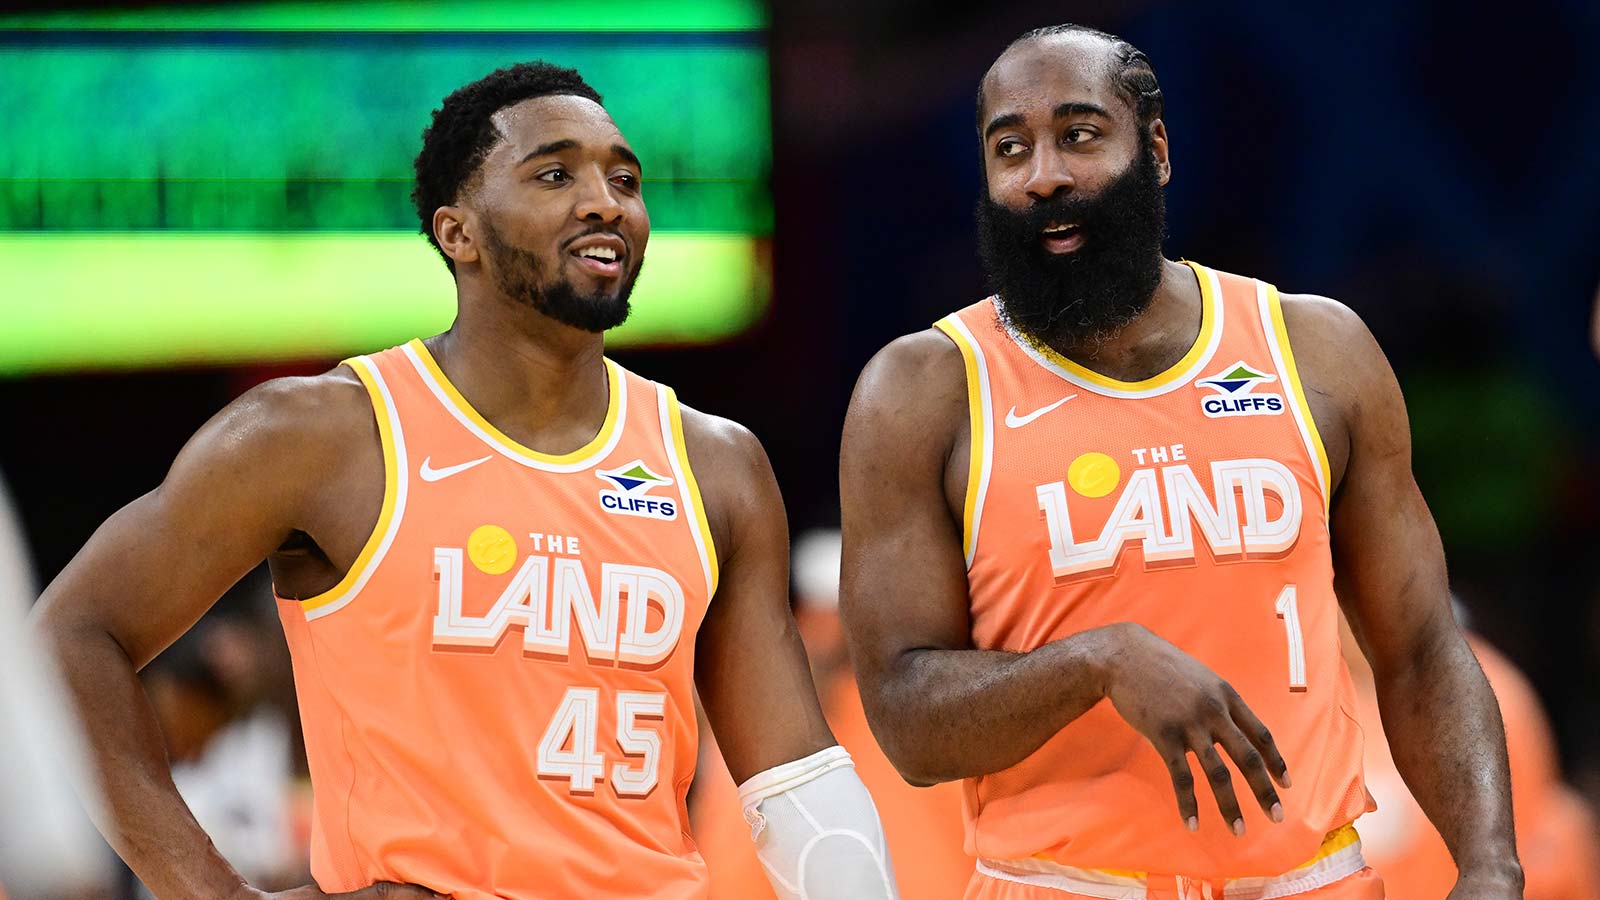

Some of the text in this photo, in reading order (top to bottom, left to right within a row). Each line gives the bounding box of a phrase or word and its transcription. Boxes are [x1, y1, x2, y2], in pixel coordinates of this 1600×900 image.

[1204, 397, 1282, 414] CLIFFS
[1132, 443, 1187, 465] THE
[601, 494, 676, 517] CLIFFS
[1035, 458, 1302, 582] LAND
[529, 532, 581, 555] THE
[432, 547, 685, 669] LAND
[1275, 584, 1307, 692] 1
[536, 686, 667, 799] 45
